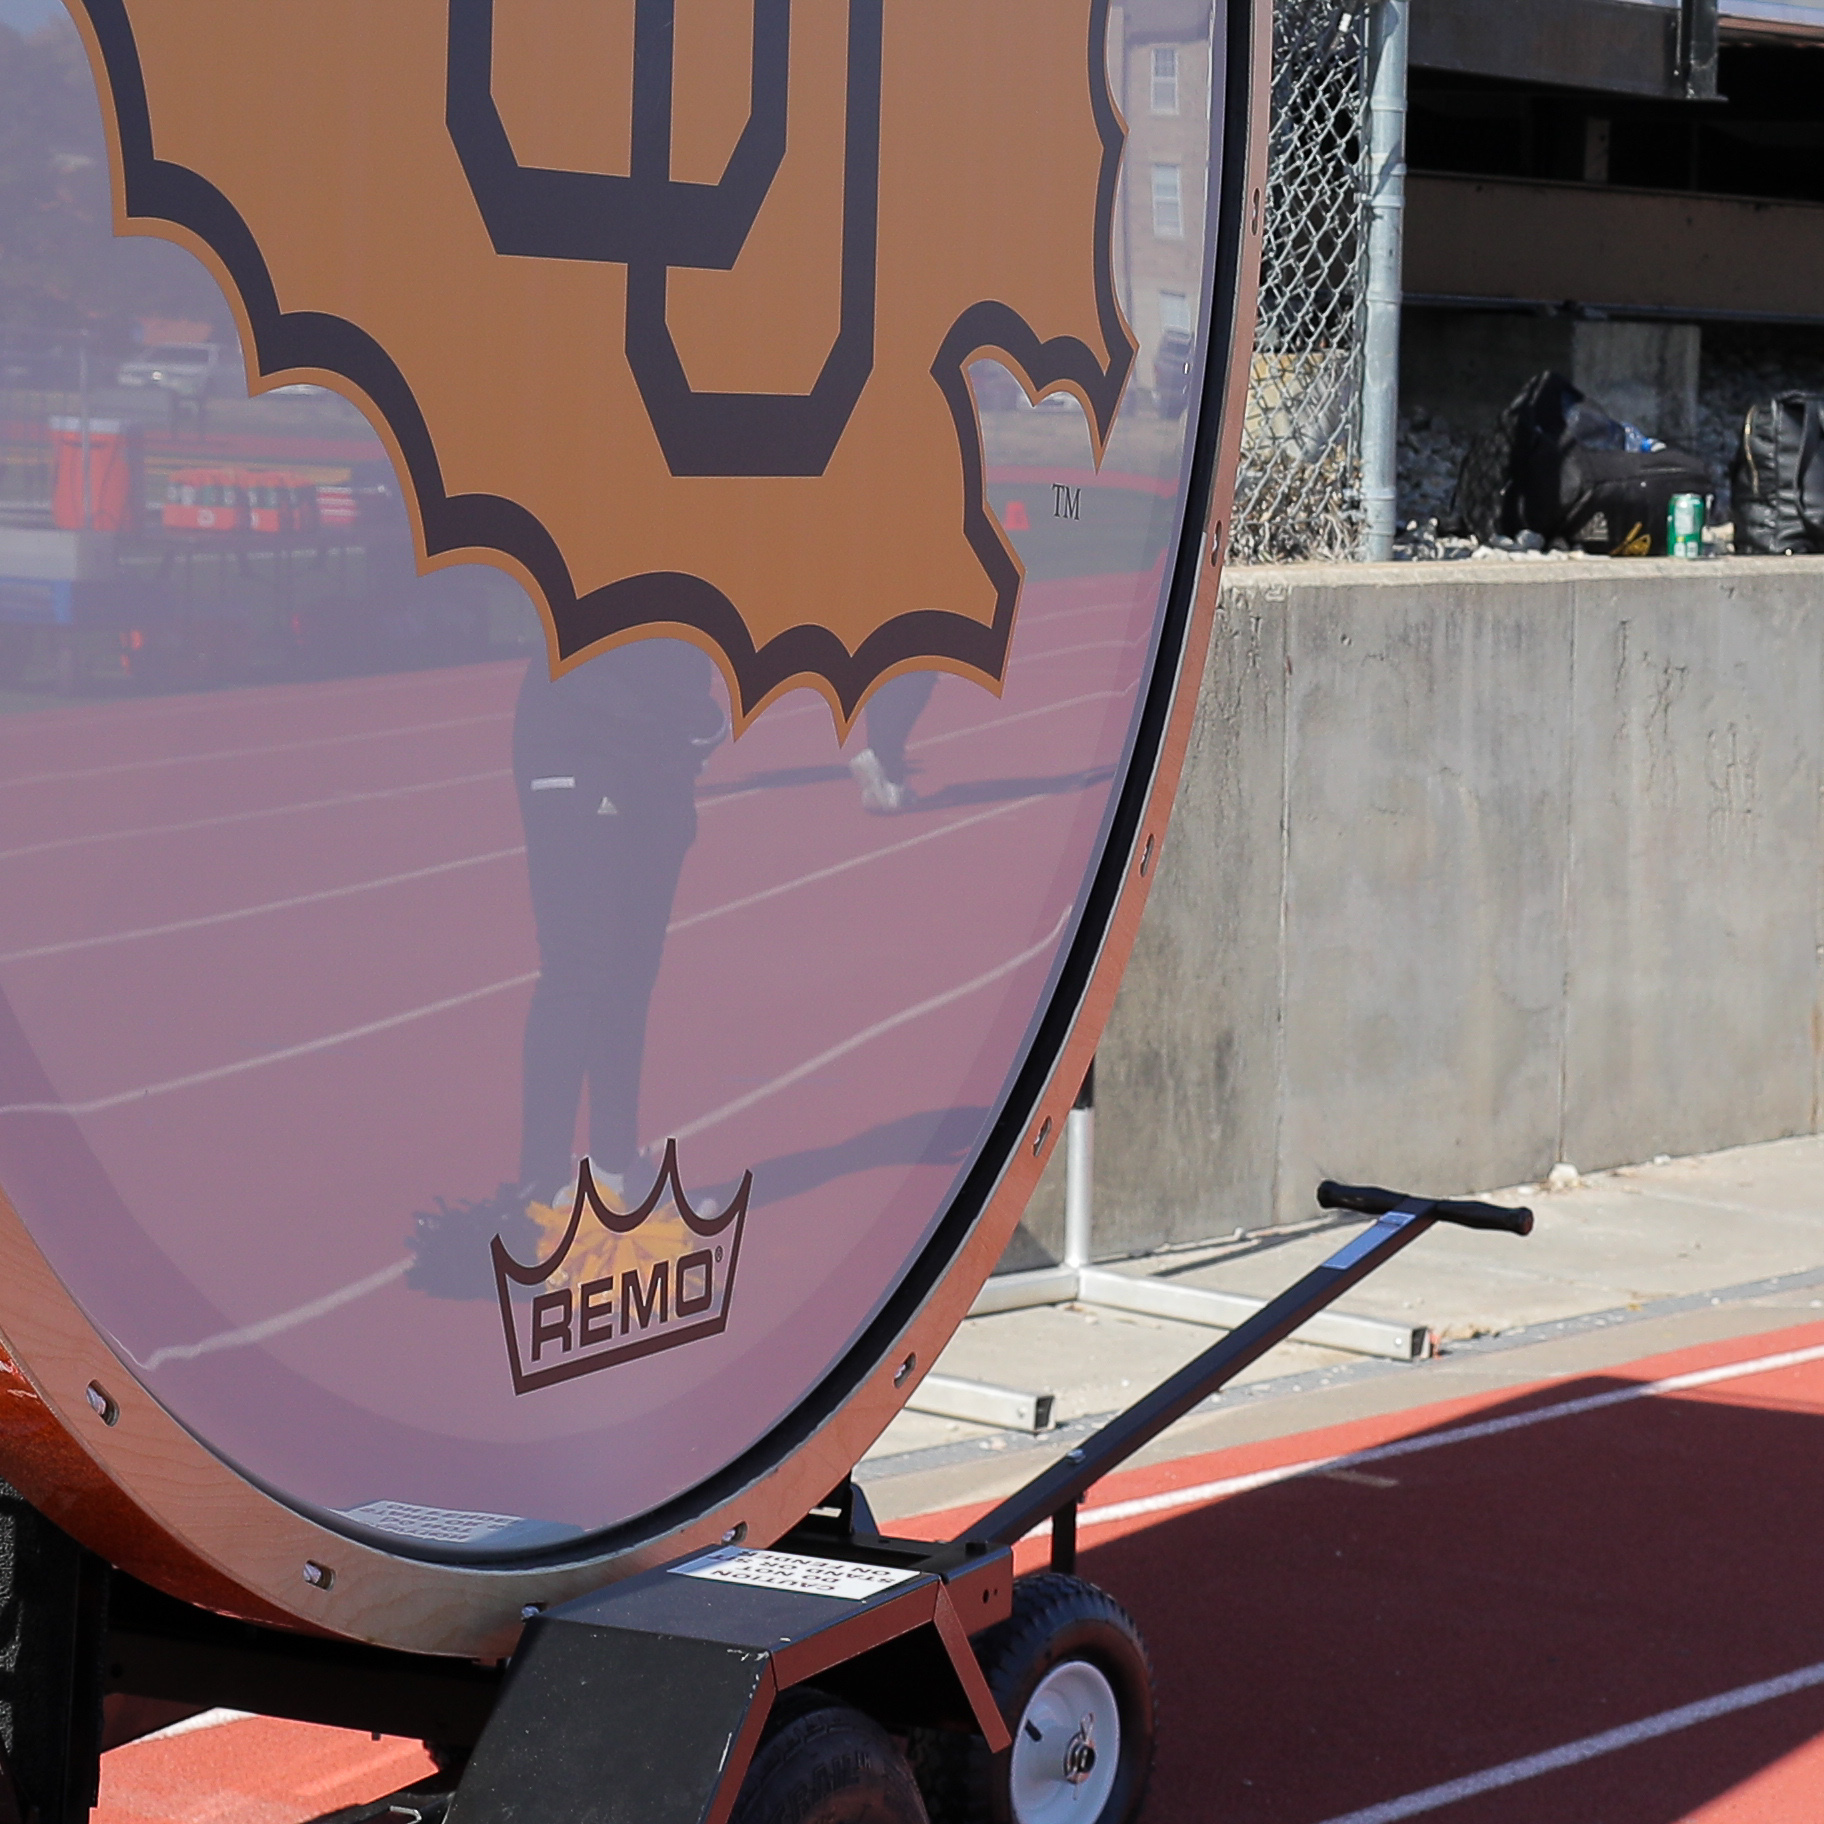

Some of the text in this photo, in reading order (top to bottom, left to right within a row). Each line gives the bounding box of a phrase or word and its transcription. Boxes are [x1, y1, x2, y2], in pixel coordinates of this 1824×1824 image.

[1052, 483, 1081, 521] TM
[739, 1551, 891, 1576] ON FENDER
[760, 1561, 797, 1570] OR
[712, 1570, 836, 1591] CAUTION
[737, 1566, 840, 1583] DO NOT
[806, 1568, 895, 1583] STAND
